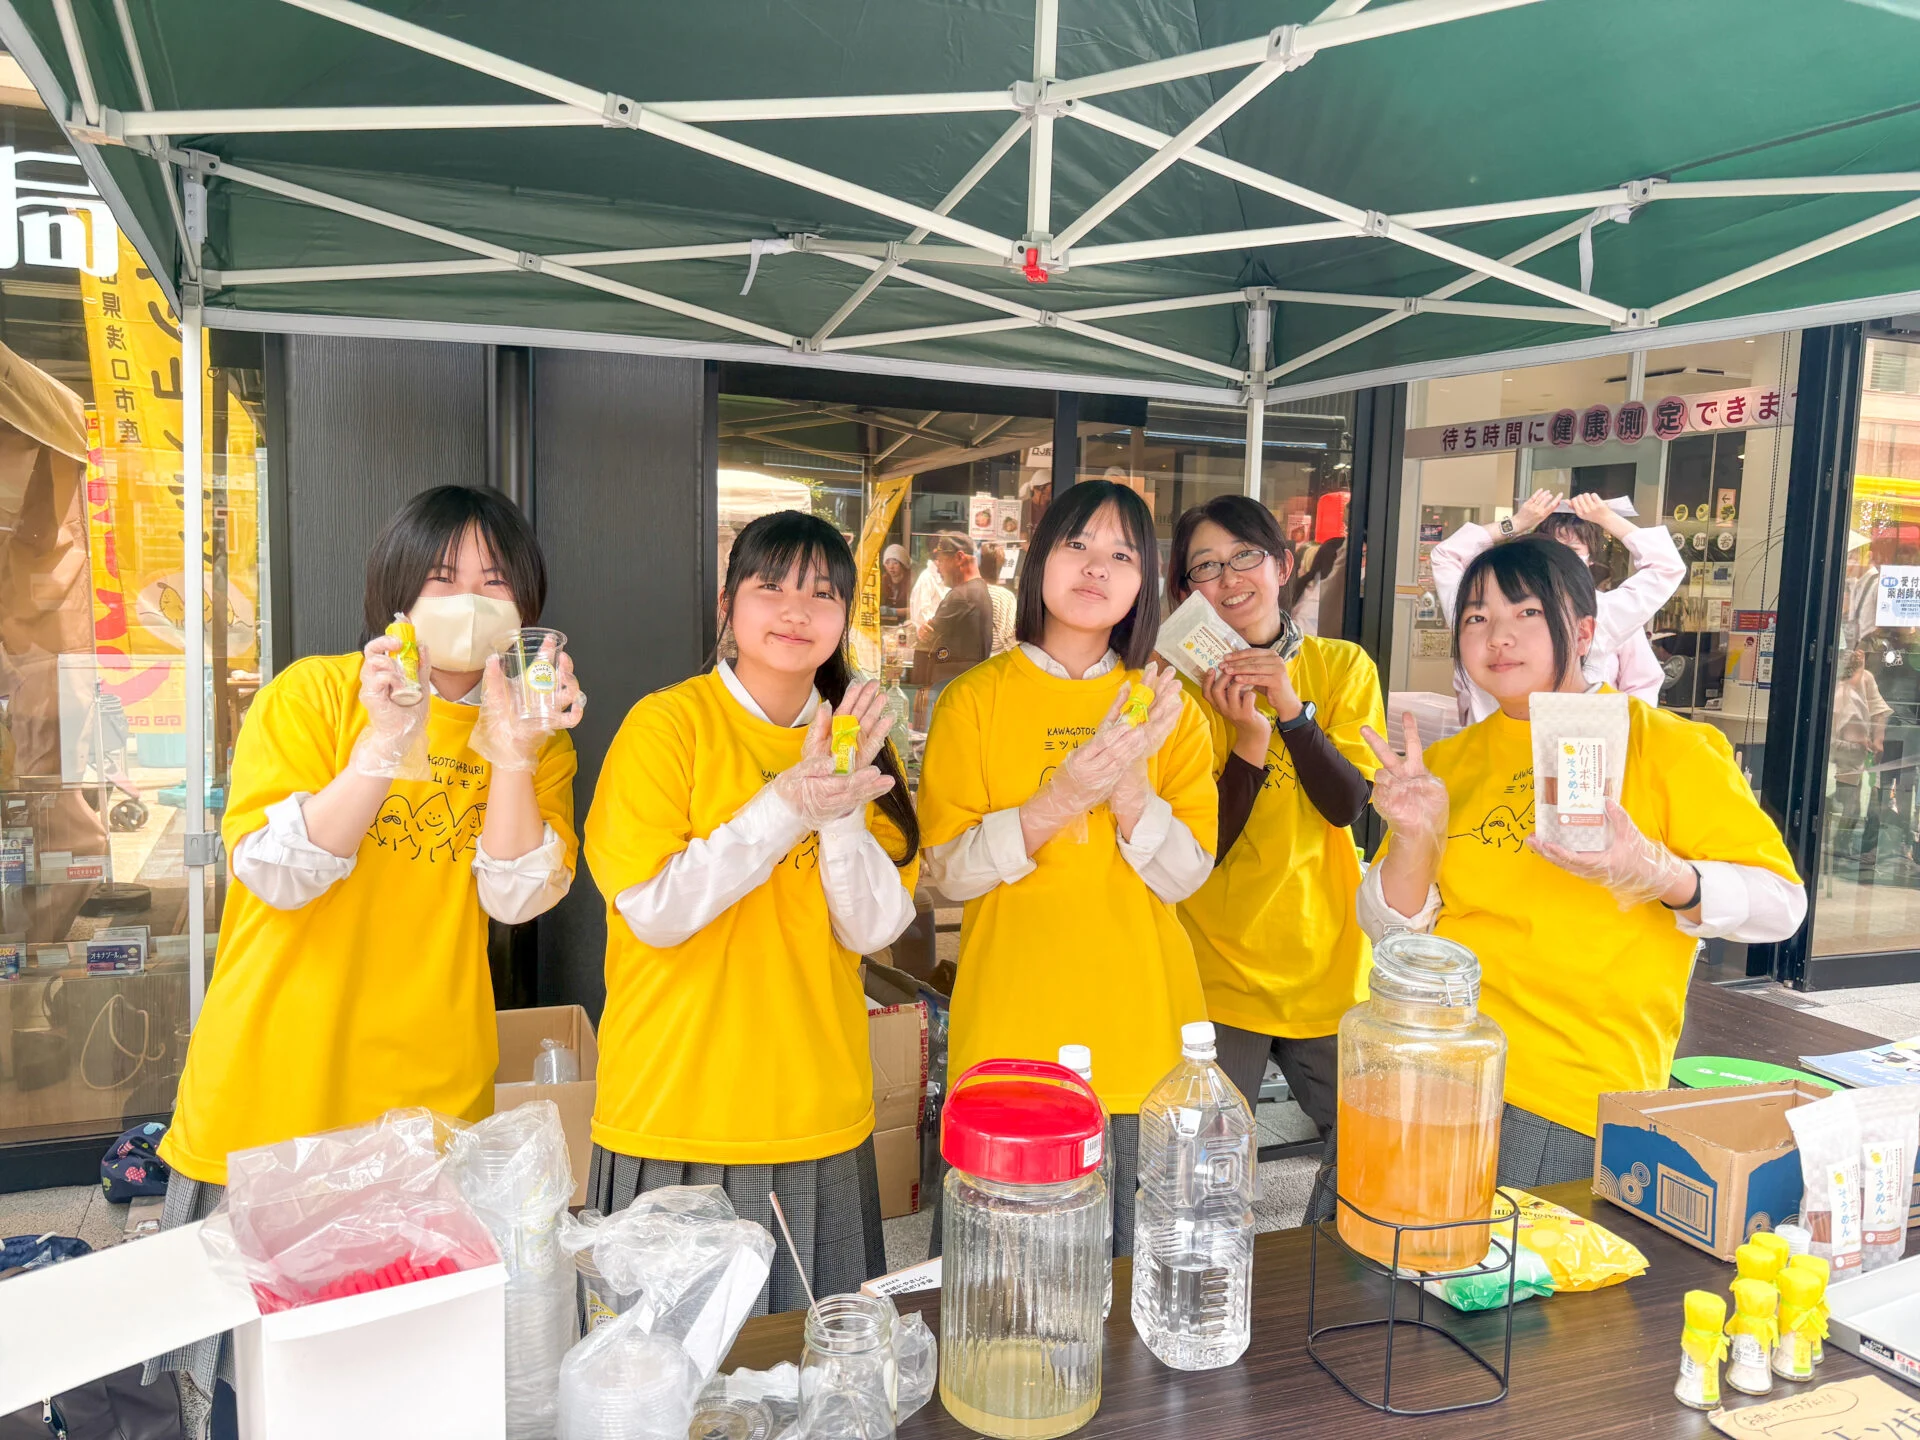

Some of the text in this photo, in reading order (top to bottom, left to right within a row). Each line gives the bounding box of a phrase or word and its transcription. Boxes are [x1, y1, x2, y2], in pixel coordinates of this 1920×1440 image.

[1442, 390, 1798, 452] 待ち時間に健康測定できま
